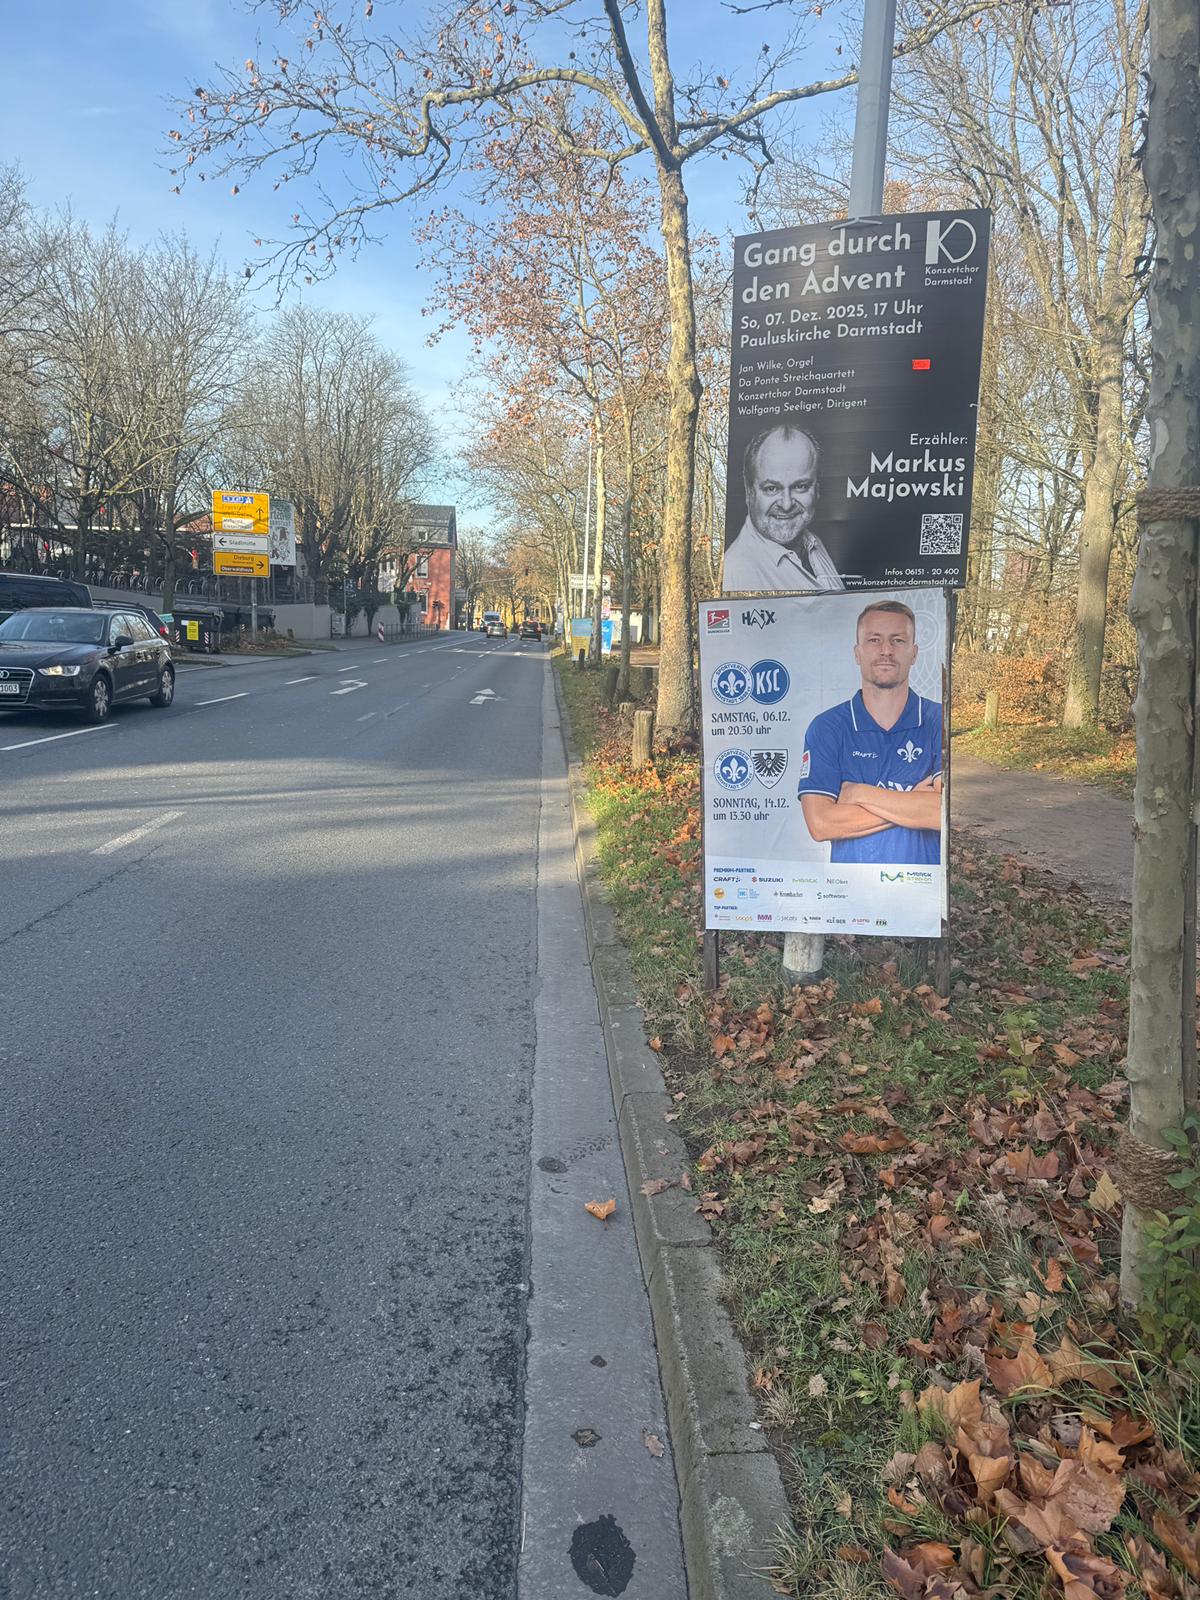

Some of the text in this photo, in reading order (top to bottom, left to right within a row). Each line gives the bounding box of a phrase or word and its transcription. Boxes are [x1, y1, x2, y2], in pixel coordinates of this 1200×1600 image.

[743, 222, 911, 268] Gang durch
[925, 265, 980, 275] Konzertchor
[741, 265, 906, 304] den Advent
[924, 277, 973, 286] Darmstadt
[740, 299, 924, 330] So, 07. Dez. 2025, 17 Uhr
[740, 319, 923, 348] Pauluskirche Darmstadt
[738, 356, 814, 375] Jan Wilke, Orgel
[738, 369, 856, 387] Da Ponte Streichquartett
[738, 384, 847, 402] Konzertchor Darmstadt
[738, 398, 867, 418] Wolfgang Seeliger, Dirigent
[909, 432, 968, 446] Erzähler:
[870, 449, 966, 474] Markus
[846, 473, 964, 503] Majowski
[885, 568, 903, 576] Infos
[905, 568, 925, 576] 06151
[944, 567, 960, 575] 400
[845, 576, 959, 587] www.konzertchor-darmstadt.de
[756, 668, 780, 695] KSC
[711, 711, 791, 724] SAMSTAG, 06.12.
[711, 724, 772, 736] um 20.30 uhr
[713, 797, 790, 810] SONNTAG, 14.12.
[713, 810, 770, 821] um 13.30 uhr
